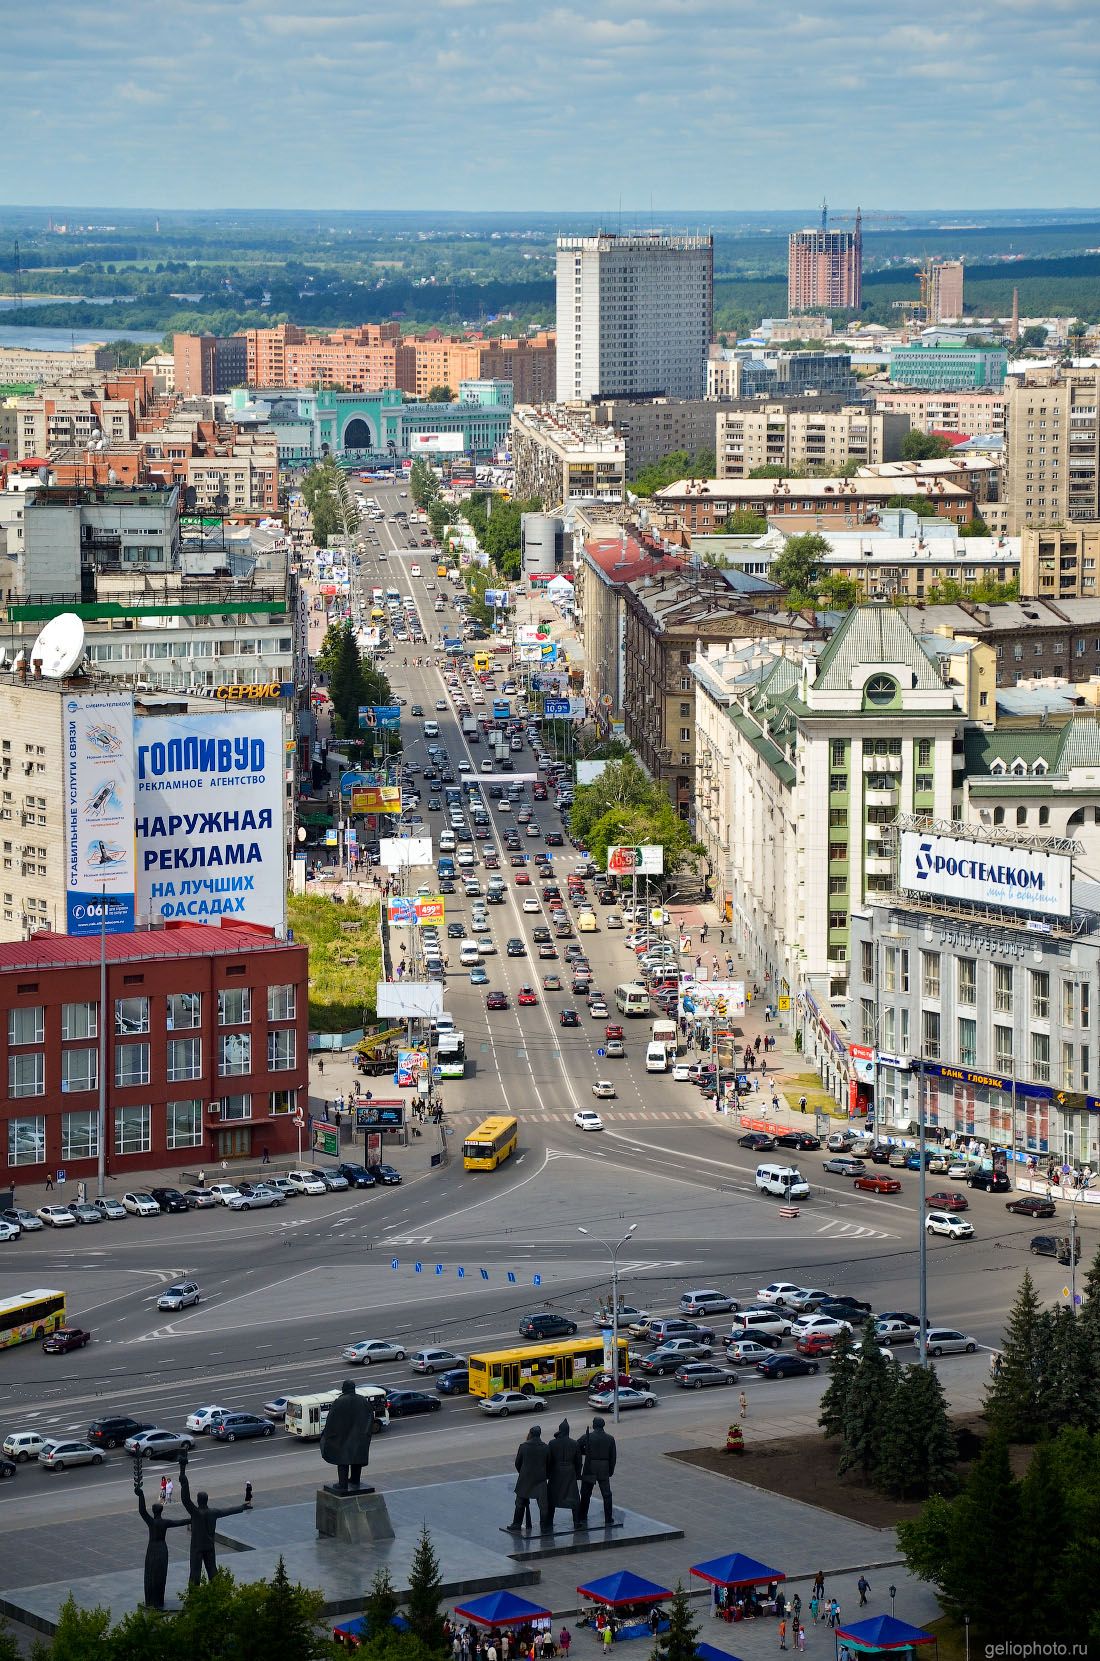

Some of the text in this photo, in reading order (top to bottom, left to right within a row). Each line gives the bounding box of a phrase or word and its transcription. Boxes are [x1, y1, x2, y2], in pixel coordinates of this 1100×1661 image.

[216, 682, 281, 700] СЕРВИС
[70, 761, 78, 805] УСЛУГИ
[138, 775, 266, 791] РЕКЛАМНОЕ АГЕНТСТВО
[135, 808, 272, 838] НАРУЖНАЯ
[70, 808, 78, 886] СТАБИЛЬНЫЕ
[143, 842, 263, 871] РЕКЛАМА
[151, 874, 255, 898] НА ЛУЧШИХ
[935, 855, 1043, 891] РОСТЕЛЕКОМ
[160, 896, 246, 919] ФАСАДАХ
[941, 1067, 1003, 1089] БАНК ГЛОБЭКС
